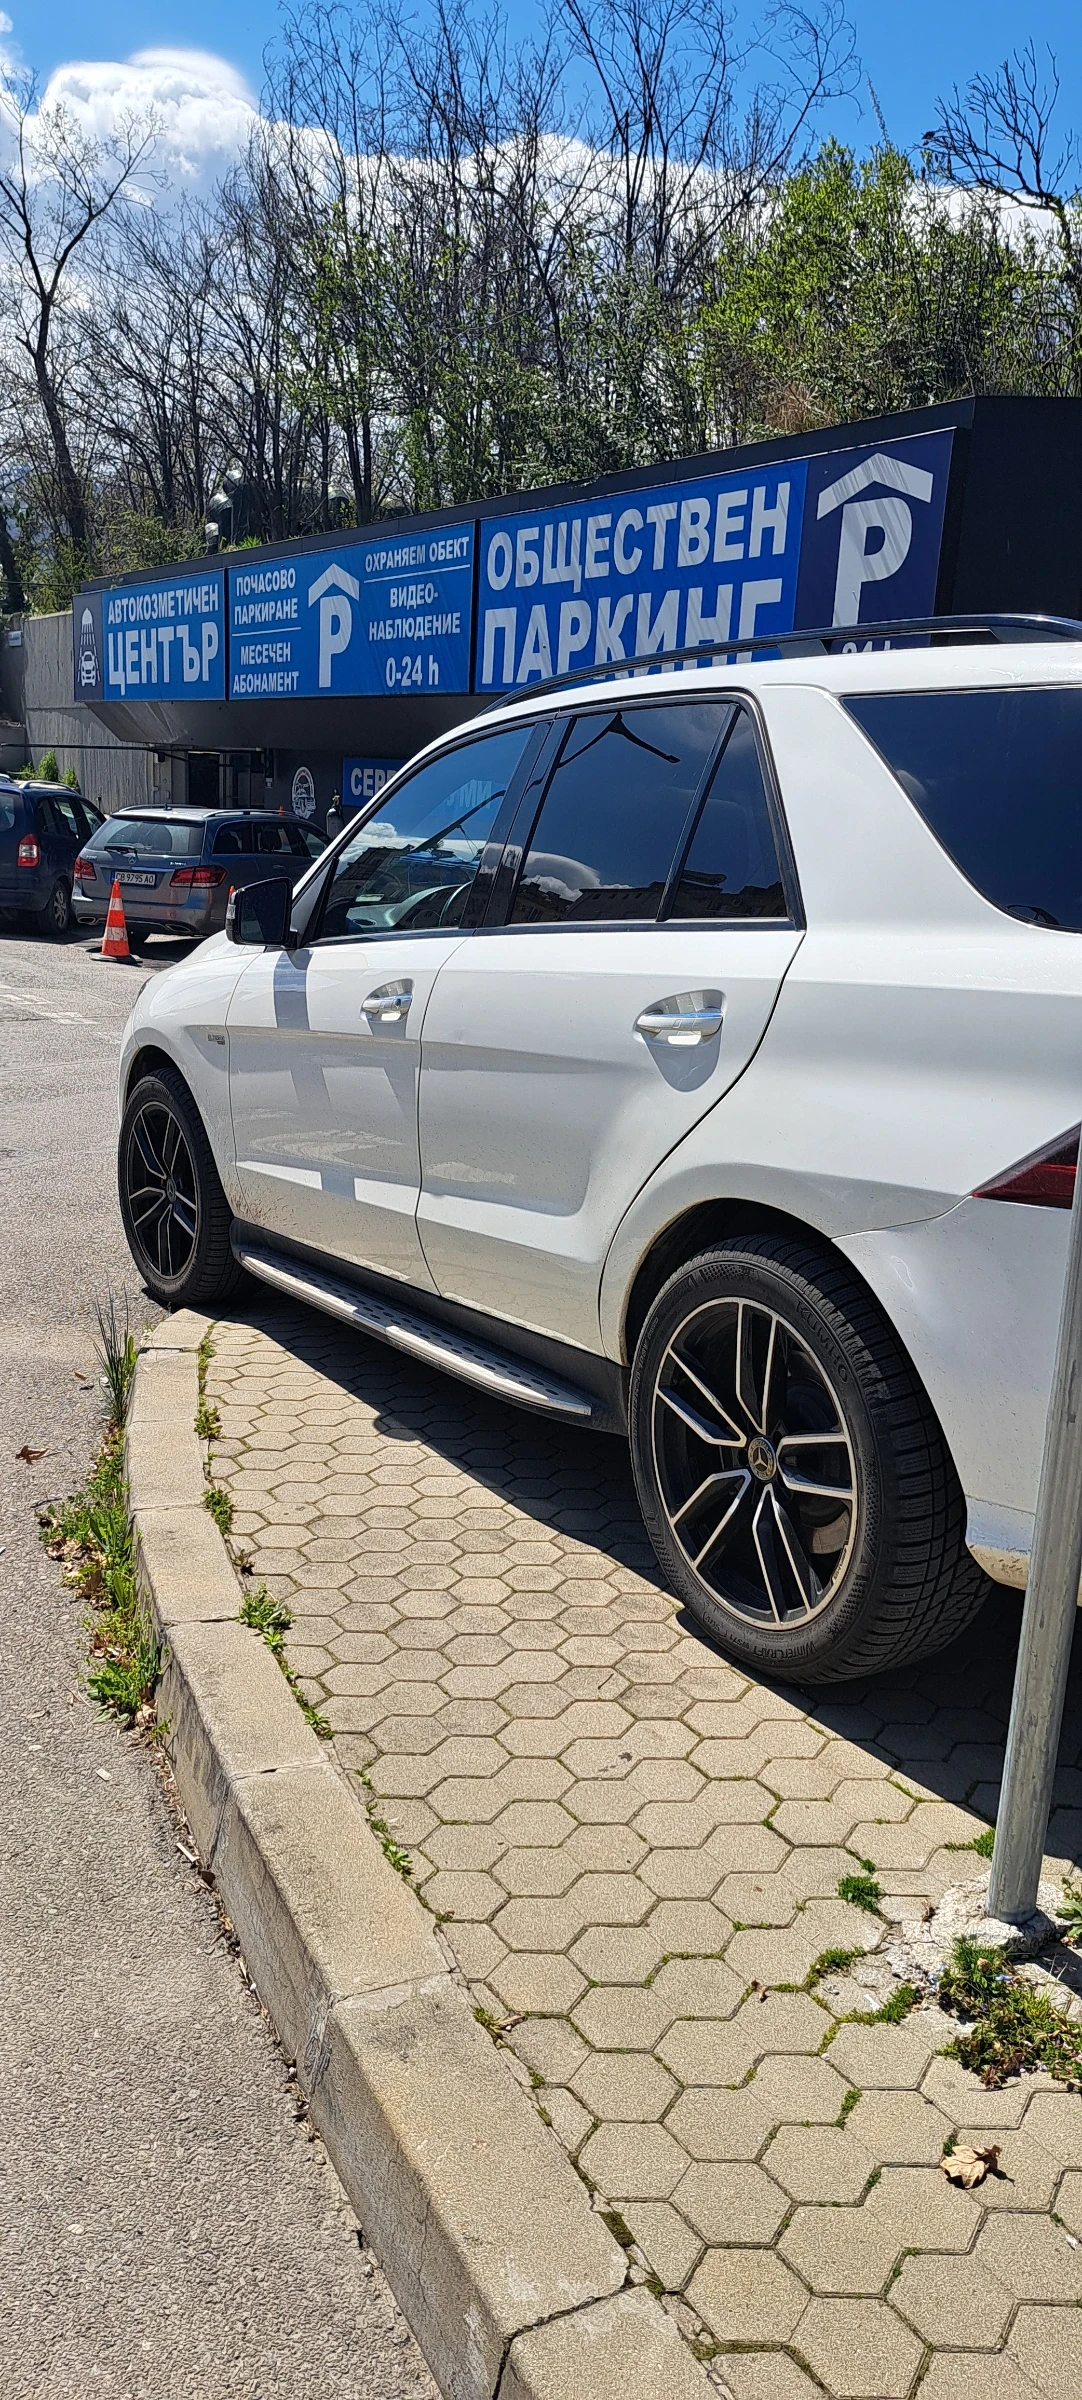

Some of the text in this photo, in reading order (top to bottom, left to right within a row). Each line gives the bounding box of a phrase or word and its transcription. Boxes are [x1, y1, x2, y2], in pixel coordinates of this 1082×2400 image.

[487, 481, 790, 593] ОБЩЕСТВЕН
[365, 536, 470, 573] ОХРАНЯЕМ ОБЕКТ
[236, 567, 296, 597] ПОЧАСОВО
[389, 582, 439, 611] ВИДЕО-
[108, 583, 219, 625] АВТОКОЗМЕТИЧЕН
[234, 598, 298, 626] ПАРКИРАНЕ
[319, 594, 352, 688] P
[369, 612, 461, 642] НАБЛЮДЕНИЕ
[481, 578, 783, 685] ПАРКИНГ
[108, 621, 219, 697] ЦЕНТЪР
[240, 641, 291, 666] МЕСЕЧЕН
[233, 671, 299, 694] АБОНАМЕНТ
[385, 654, 439, 688] 0-24 h
[126, 873, 143, 883] 9795
[797, 1299, 849, 1384] KUMHO
